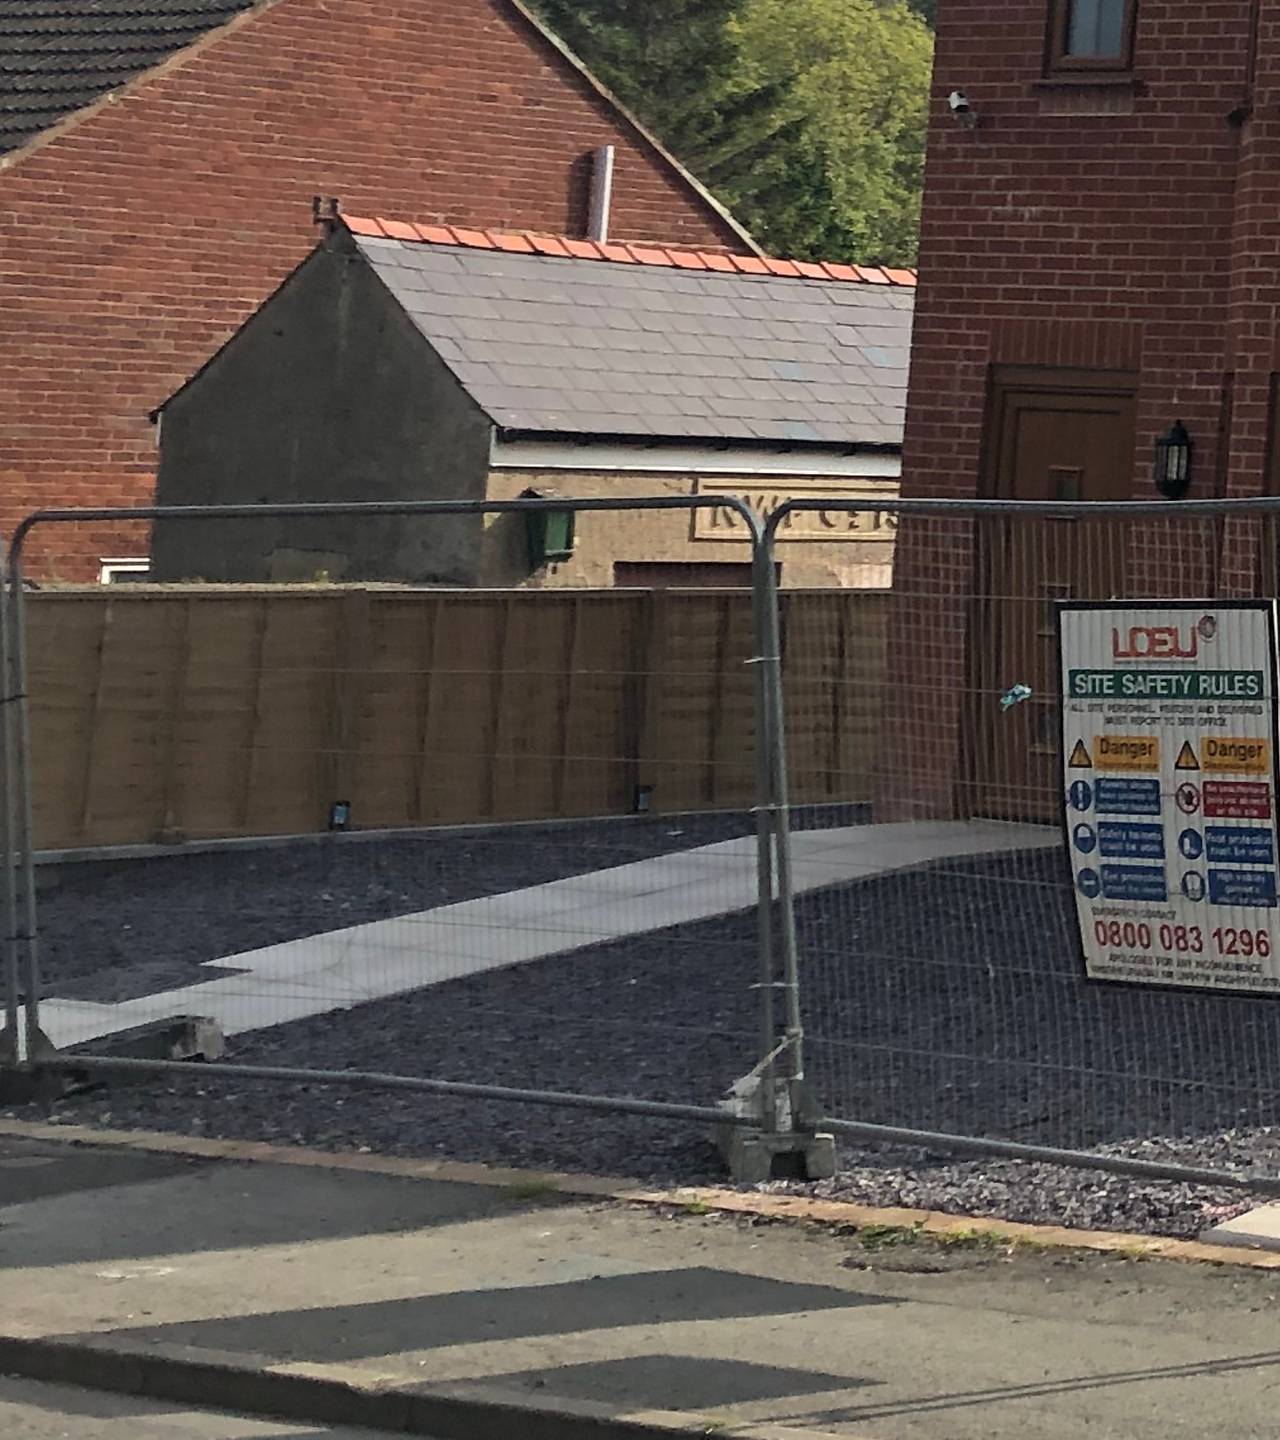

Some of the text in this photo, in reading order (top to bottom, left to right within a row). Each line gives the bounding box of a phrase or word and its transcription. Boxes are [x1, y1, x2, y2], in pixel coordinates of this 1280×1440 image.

[1074, 674, 1259, 696] SITE SAFETY RULES
[1100, 737, 1155, 759] Danger
[1206, 739, 1264, 762] Danger
[1094, 920, 1270, 957] 0800 083 1296
